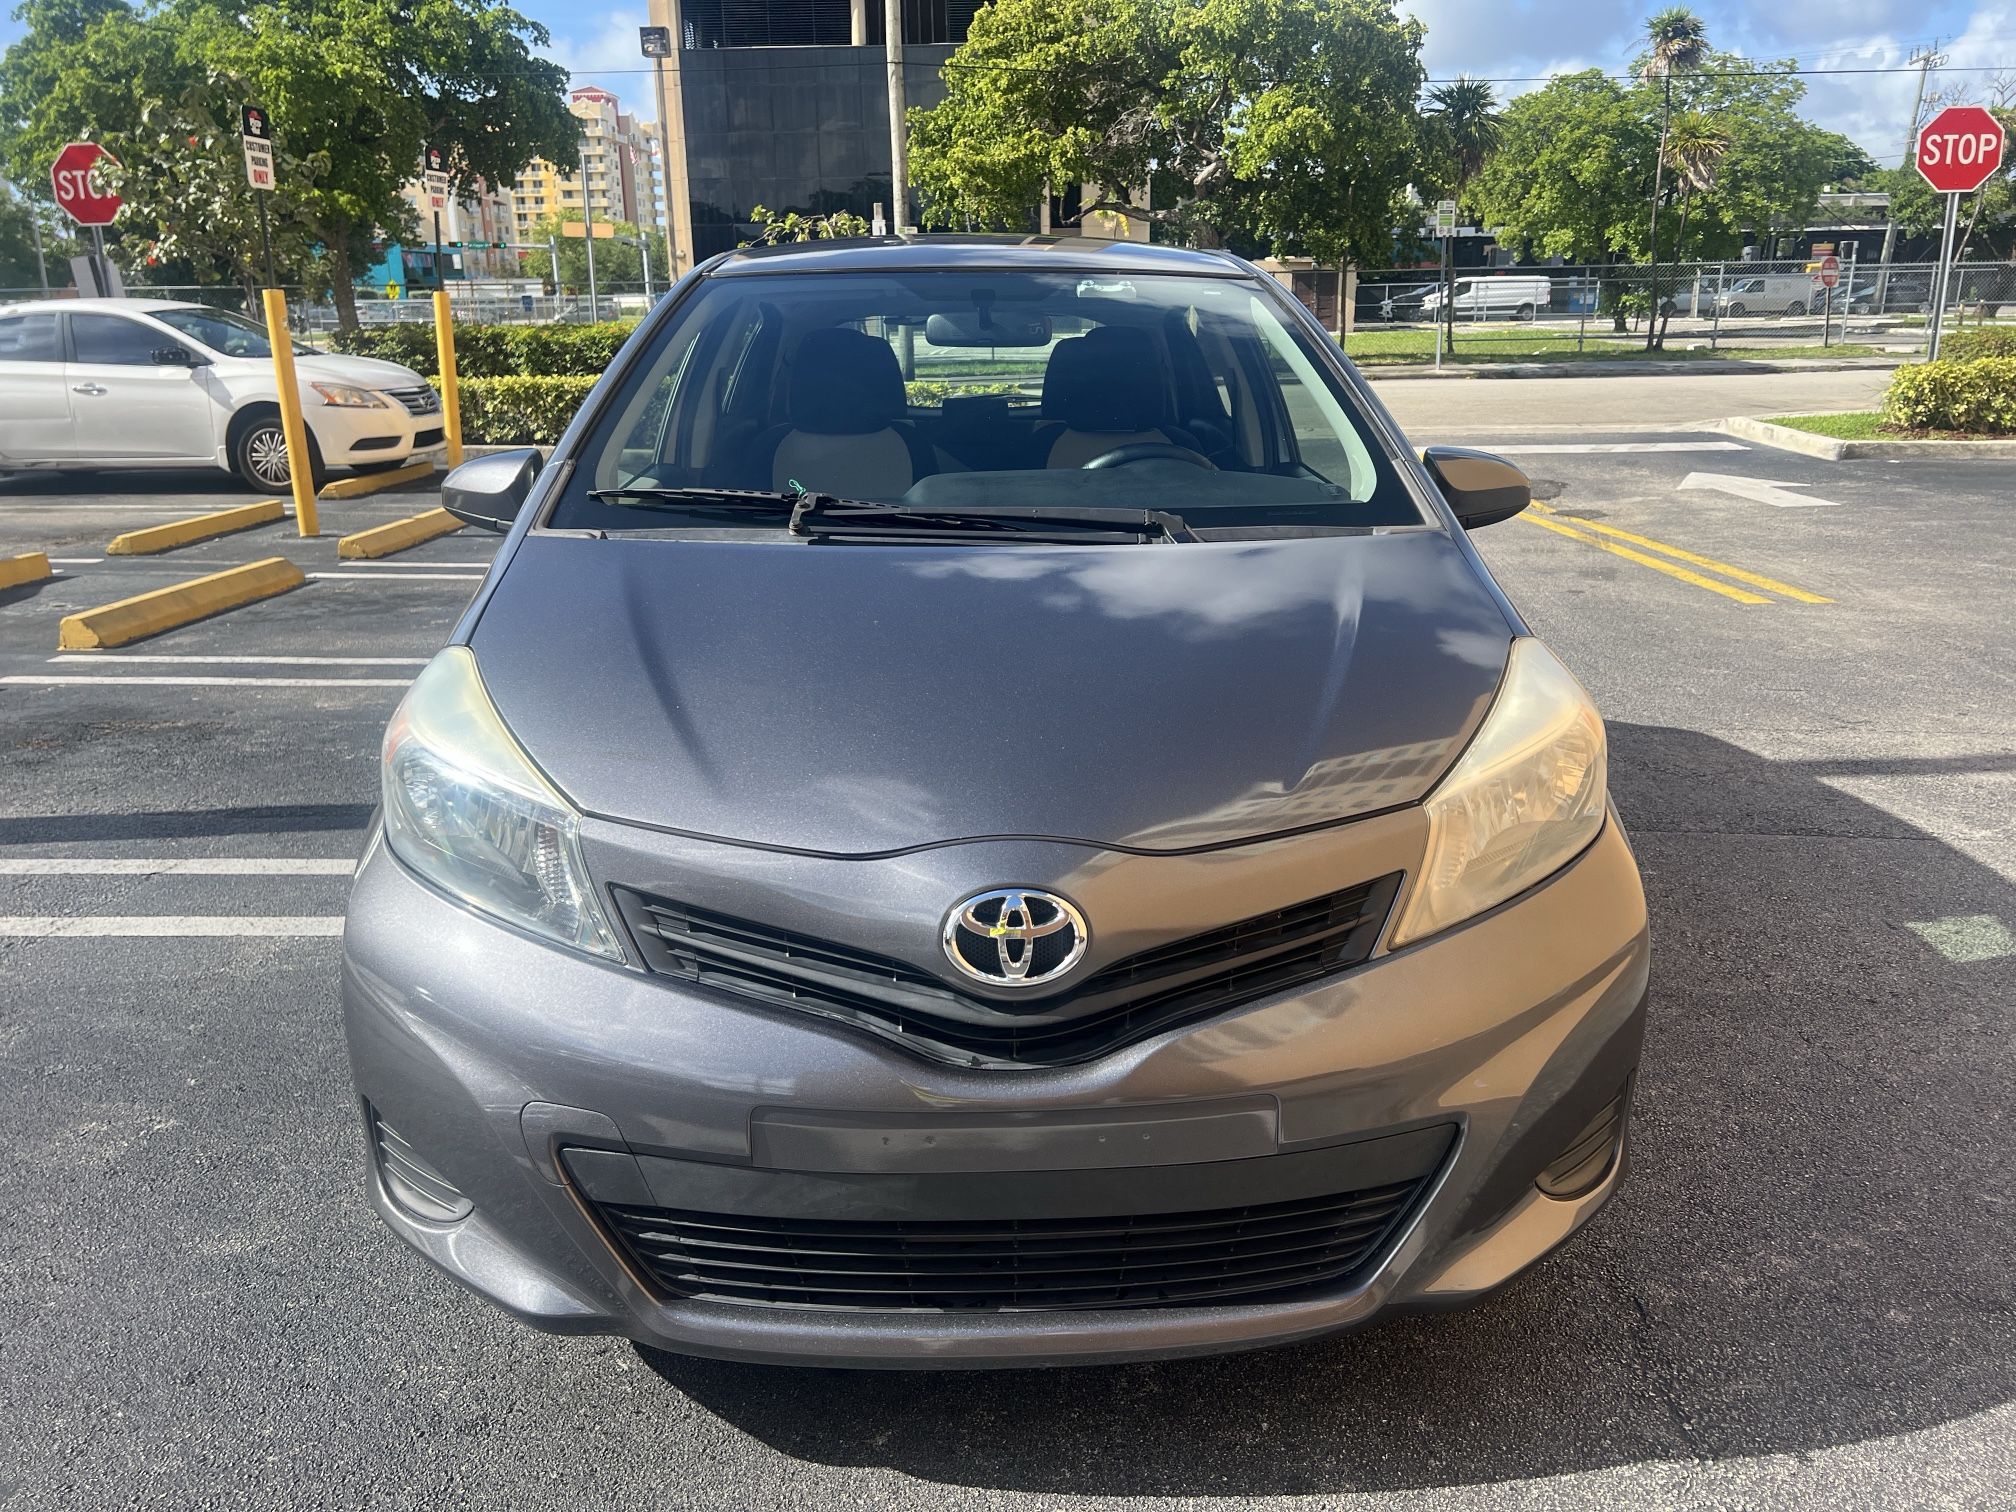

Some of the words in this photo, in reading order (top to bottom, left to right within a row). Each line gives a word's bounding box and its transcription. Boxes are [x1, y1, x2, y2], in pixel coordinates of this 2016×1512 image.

[246, 141, 270, 154] CUSTOMER
[1923, 133, 1998, 166] STOP
[251, 155, 268, 168] PARKING
[58, 169, 118, 201] STO
